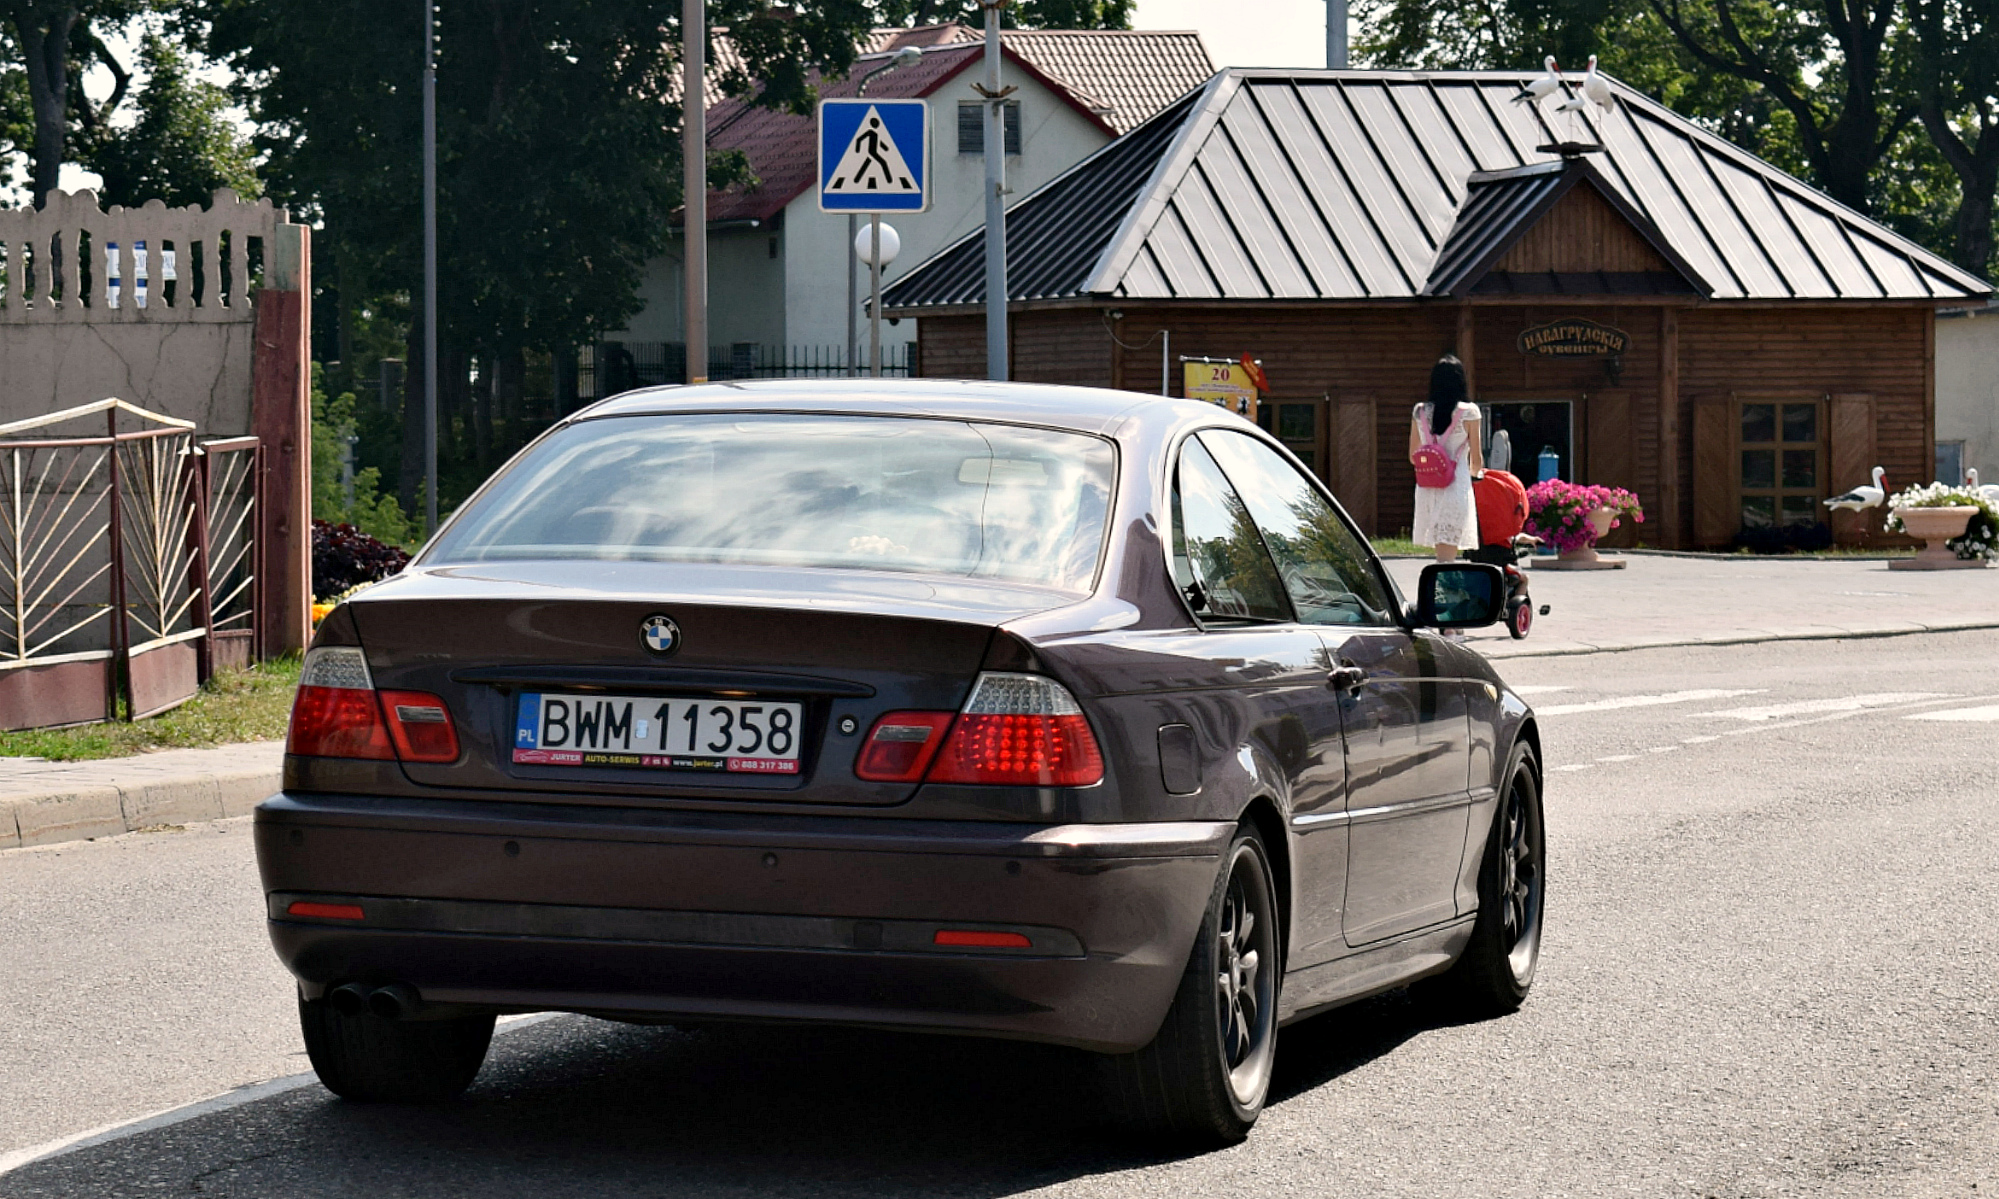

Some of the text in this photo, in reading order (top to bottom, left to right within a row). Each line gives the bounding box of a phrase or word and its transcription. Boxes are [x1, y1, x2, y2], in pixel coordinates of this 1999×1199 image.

[1212, 368, 1230, 381] 20
[542, 699, 793, 755] BWM 11358
[518, 729, 535, 743] PL
[550, 753, 581, 762] JURTER
[585, 754, 640, 764] AUTO-SERWIS
[673, 758, 723, 769] www.jurter.pl
[760, 761, 775, 770] 317
